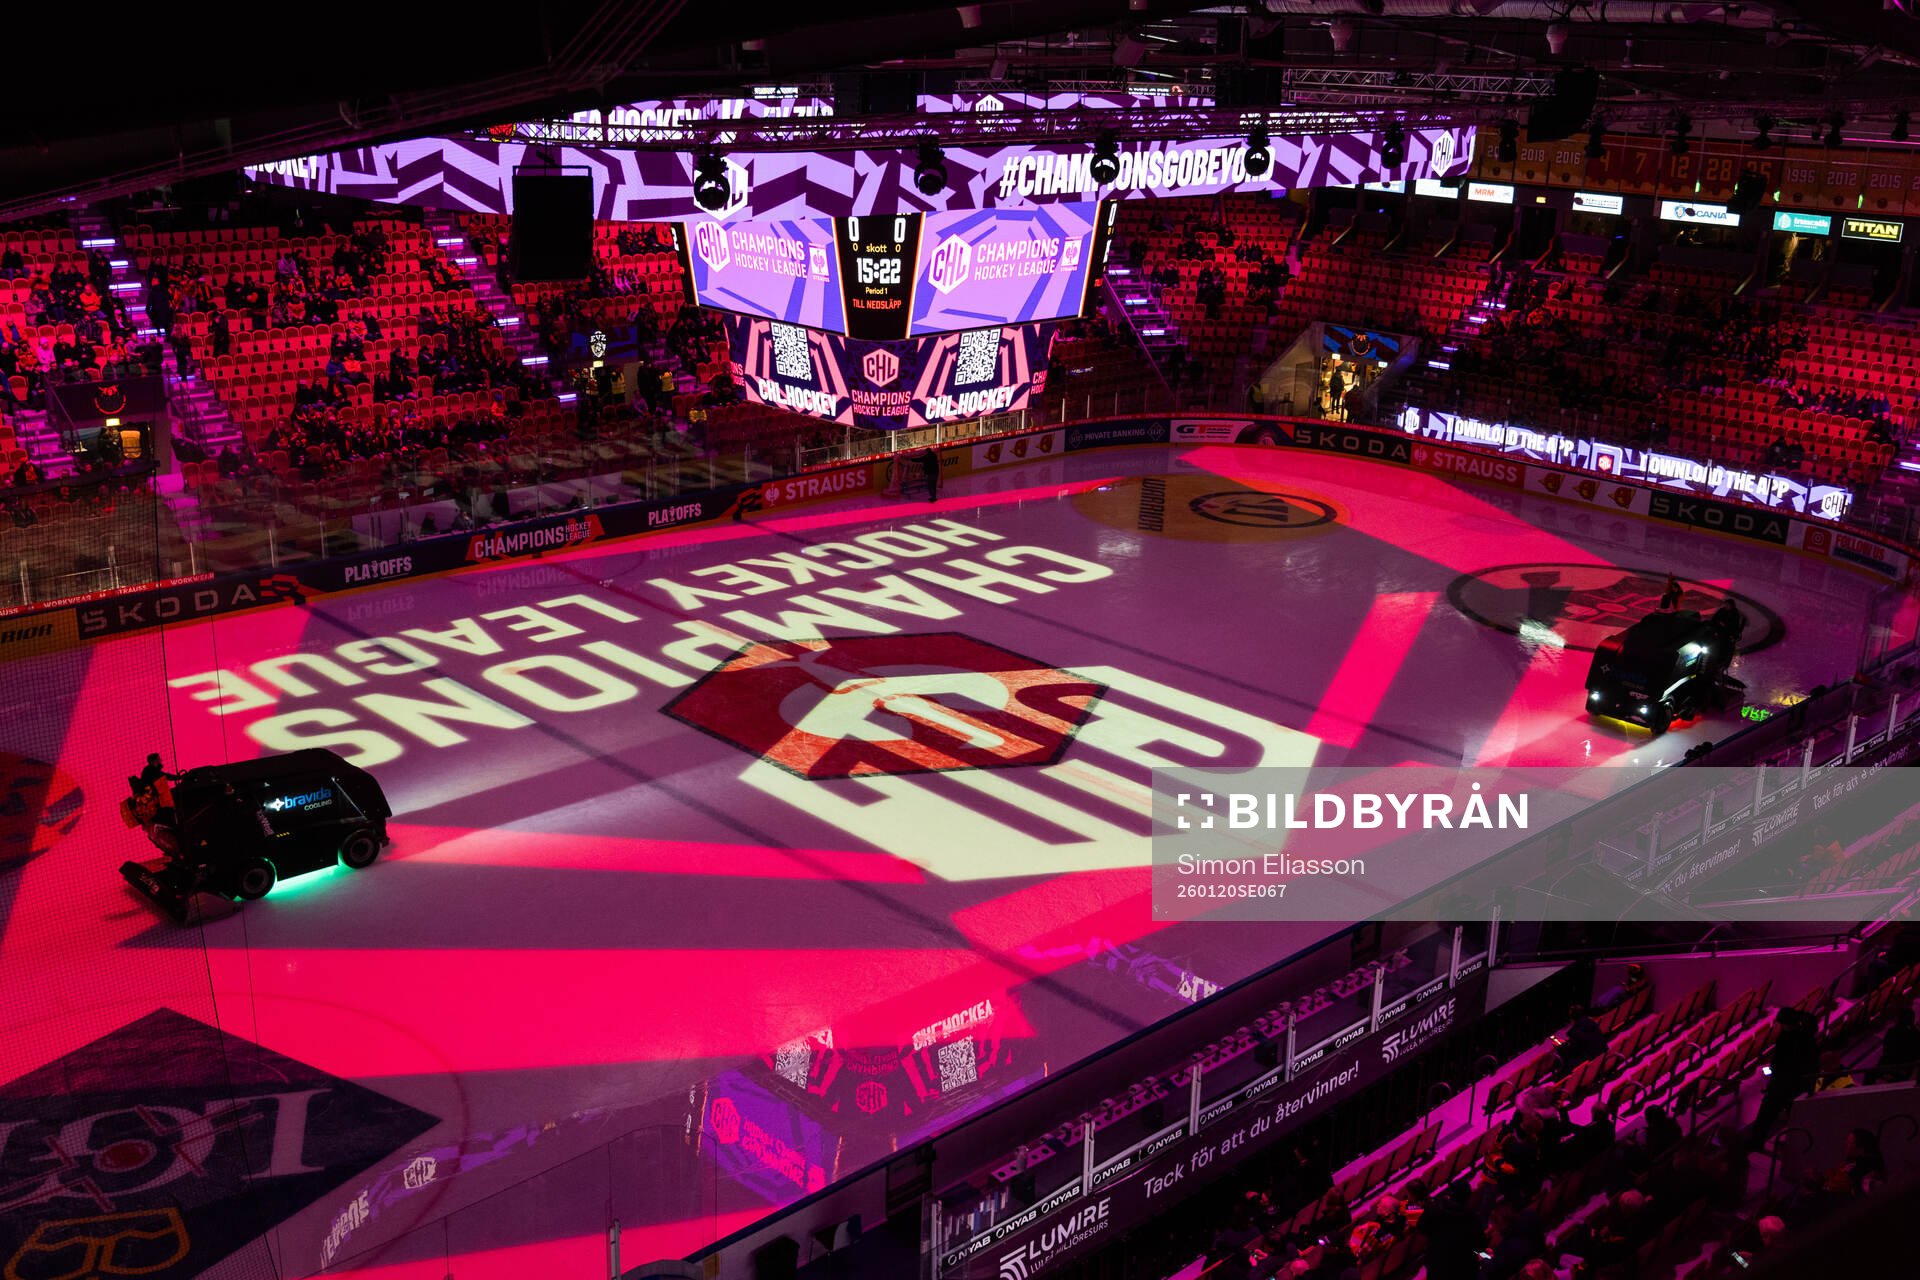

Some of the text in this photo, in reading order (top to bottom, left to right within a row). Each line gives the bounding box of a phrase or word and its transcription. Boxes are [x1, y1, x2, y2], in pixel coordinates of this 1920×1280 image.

[1520, 149, 1545, 162] 2018
[1634, 152, 1647, 175] 7
[847, 216, 860, 242] 0
[894, 217, 906, 243] 0
[1847, 221, 1899, 236] TITAN
[731, 231, 805, 261] CHAMPIONS
[866, 243, 887, 253] skott
[976, 237, 1060, 264] CHAMPIONS
[735, 253, 808, 279] HOCKEY LEAGUE
[856, 257, 902, 284] 15:22
[973, 259, 1057, 281] HOCKEY LEAGUE
[865, 286, 884, 295] Period
[853, 299, 865, 309] TILL
[865, 352, 898, 383] CHL
[758, 378, 837, 418] CHL.HOCKEY
[851, 389, 911, 407] CHAMPIONS
[853, 404, 910, 416] HOCKEY LEAGUE
[925, 385, 1016, 420] CHL.HOCKEY
[1519, 431, 1545, 453] THE
[1433, 451, 1518, 484] STRAUSS
[785, 469, 867, 499] STRAUSS
[1726, 471, 1757, 493] THE
[565, 521, 592, 534] HOCKEY
[565, 529, 592, 541] LEAGUE
[473, 524, 566, 560] CHAMPIONS
[167, 518, 1006, 716] HOCKEY LEAGUE
[284, 786, 333, 810] bravida
[1401, 996, 1457, 1046] LUMIRE
[1340, 1026, 1365, 1045] NYAB
[1300, 1050, 1325, 1069] NYAB
[1252, 1075, 1279, 1096] NYAB
[1206, 1100, 1234, 1121] NYAB
[1143, 1060, 1360, 1199] Tack för att du återvinner!
[1154, 1128, 1183, 1151] NYAB
[1101, 1157, 1132, 1182] NYAB
[1049, 1185, 1081, 1209] NYAB
[1005, 1209, 1038, 1234] NYAB
[1029, 1196, 1112, 1260] LUMIRE
